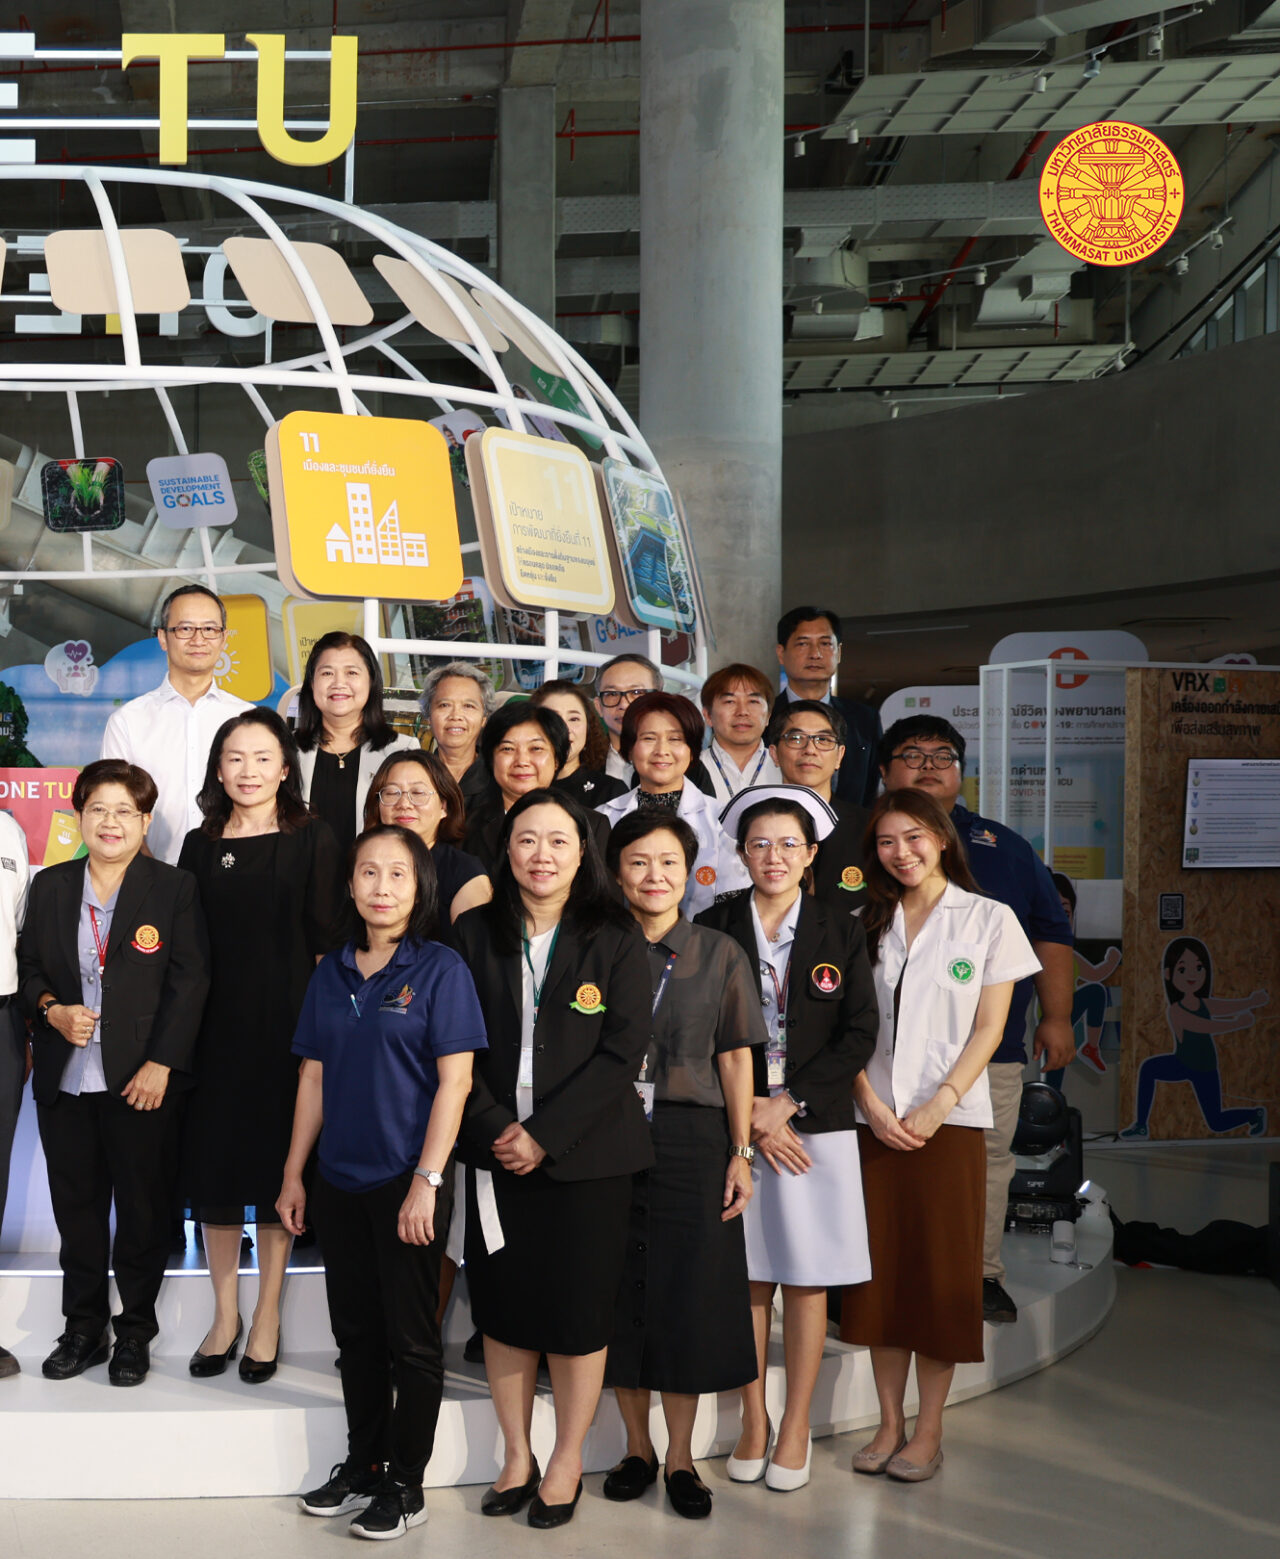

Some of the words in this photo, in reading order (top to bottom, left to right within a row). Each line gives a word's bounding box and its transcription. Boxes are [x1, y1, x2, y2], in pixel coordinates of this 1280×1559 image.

[122, 33, 358, 167] TU
[299, 432, 320, 453] 11
[303, 458, 396, 477] เมืองและชุมชนที่ยั่งยืน
[158, 474, 219, 486] SUSTAINABLE
[160, 483, 221, 494] DEVELOPMENT
[543, 464, 585, 515] 11
[163, 490, 225, 508] GOALS
[509, 501, 543, 521] เป้าหมาย
[1172, 672, 1210, 692] VRX
[43, 781, 72, 799] TU
